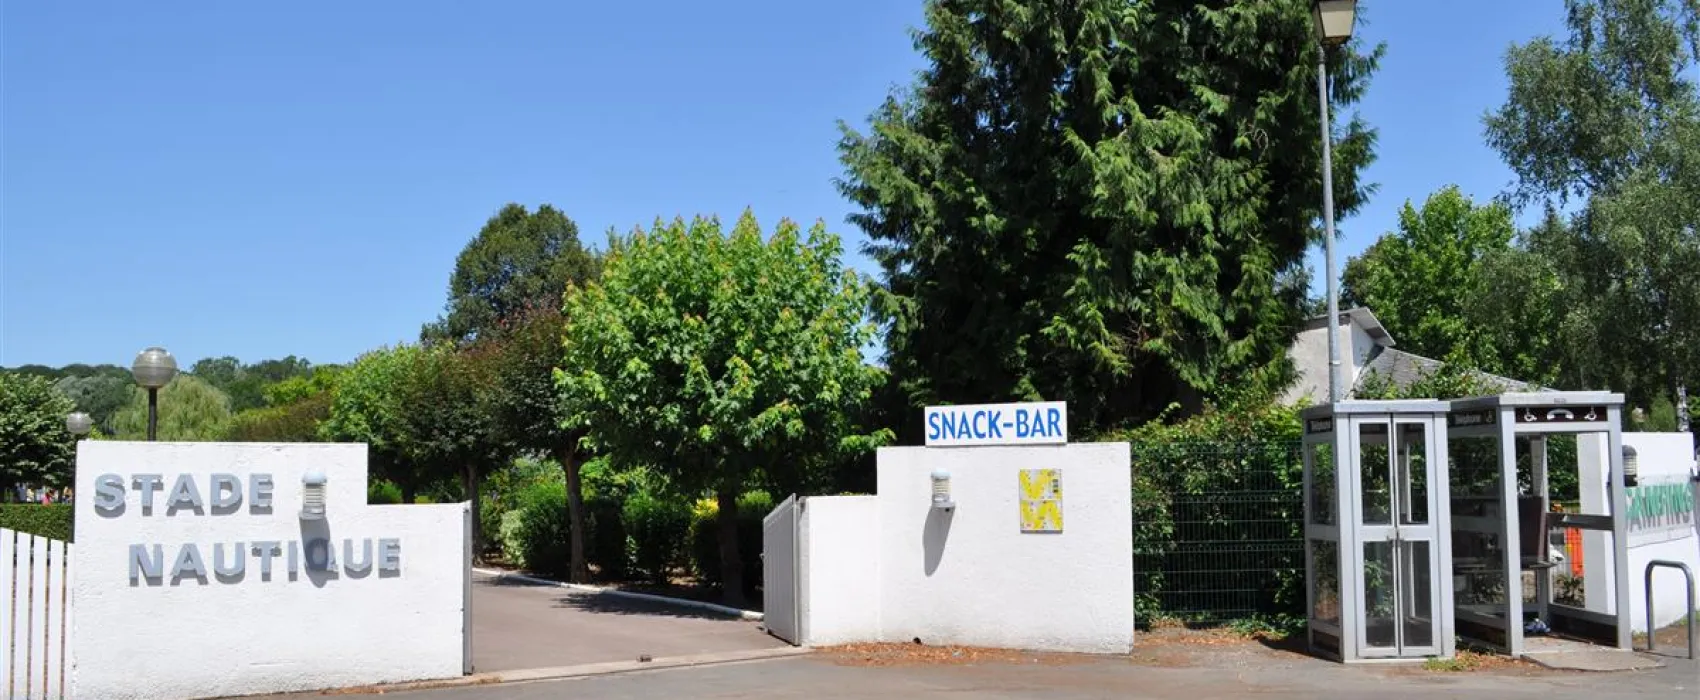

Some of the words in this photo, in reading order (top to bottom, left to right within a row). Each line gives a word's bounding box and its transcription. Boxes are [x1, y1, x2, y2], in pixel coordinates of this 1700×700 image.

[928, 409, 1062, 440] SNACK-BAR
[93, 473, 273, 511] STADE
[128, 539, 401, 583] NAUTIQUE
